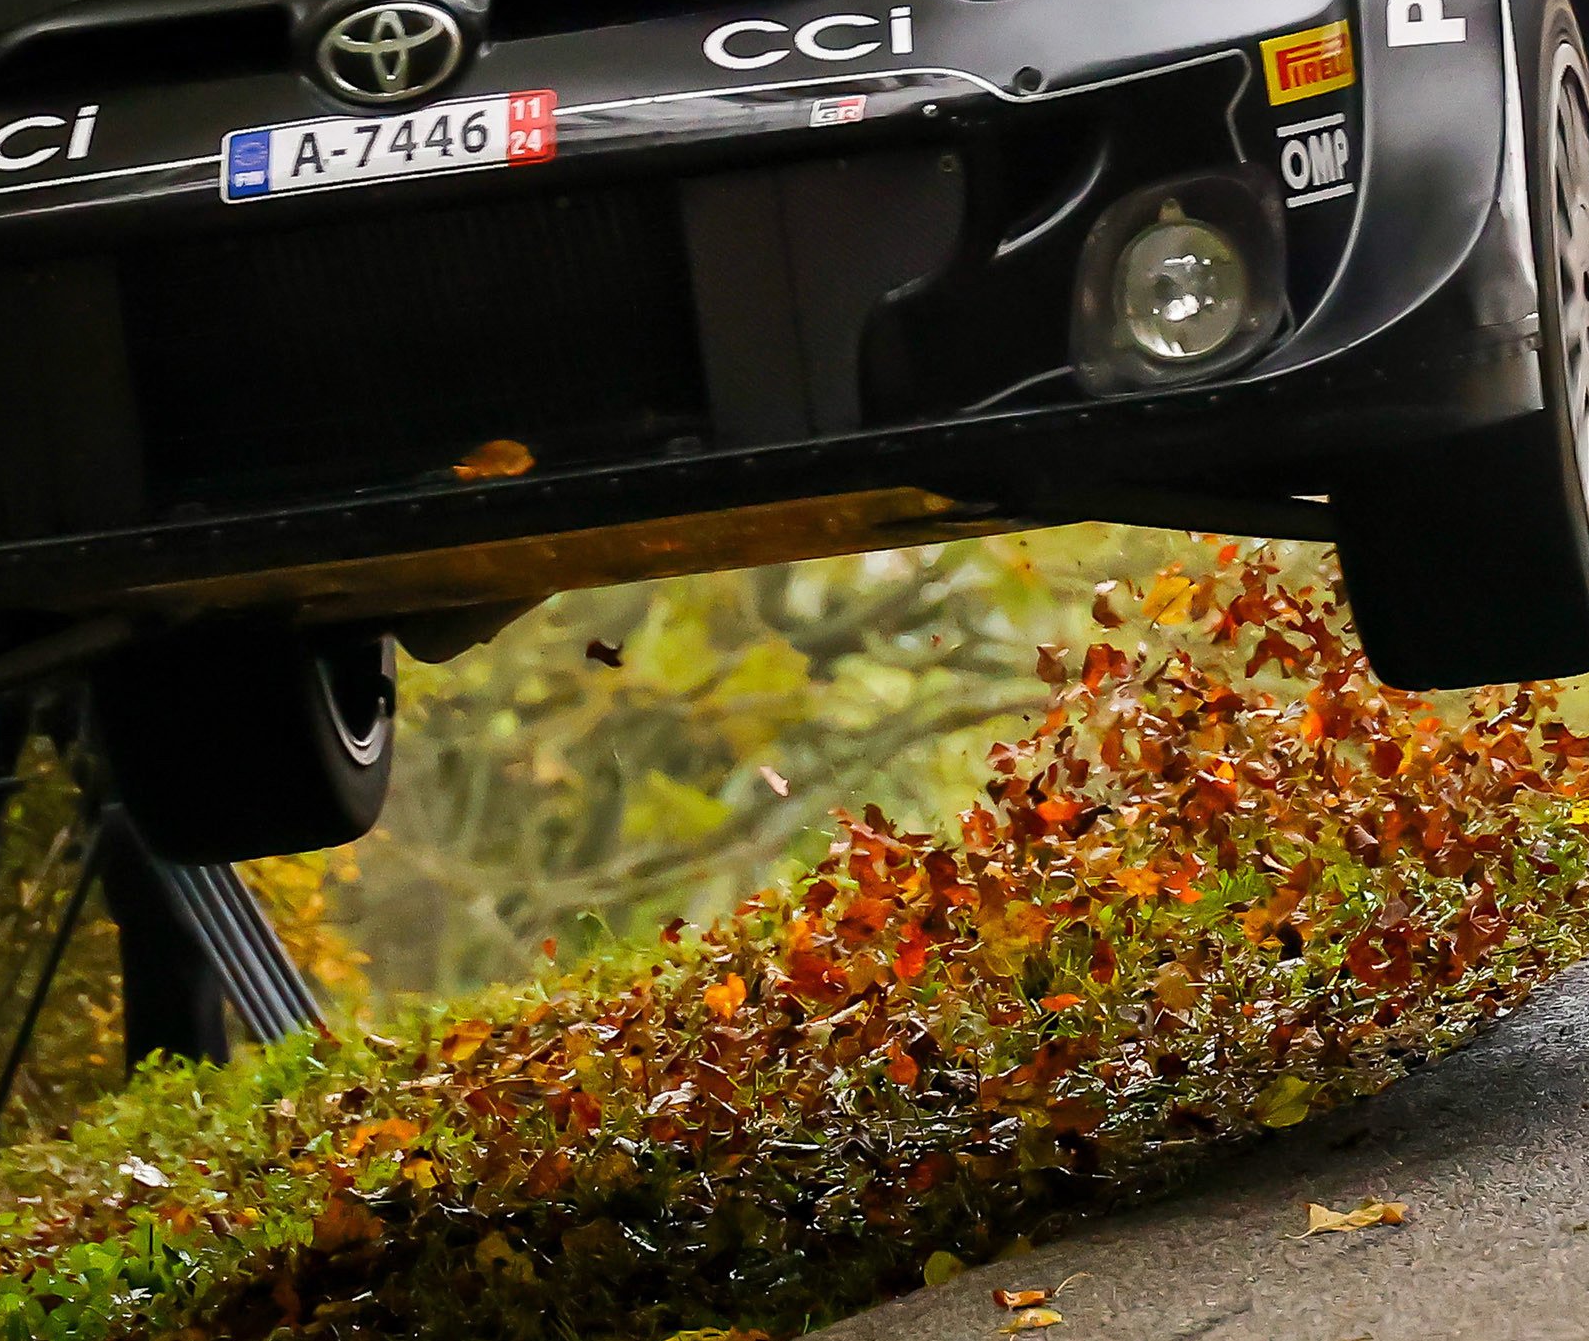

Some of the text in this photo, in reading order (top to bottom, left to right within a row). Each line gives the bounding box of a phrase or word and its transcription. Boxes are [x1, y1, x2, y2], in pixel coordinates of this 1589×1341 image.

[510, 98, 542, 121] 11
[290, 110, 489, 178] A-7446
[509, 129, 543, 155] 24
[1280, 127, 1350, 190] OMP
